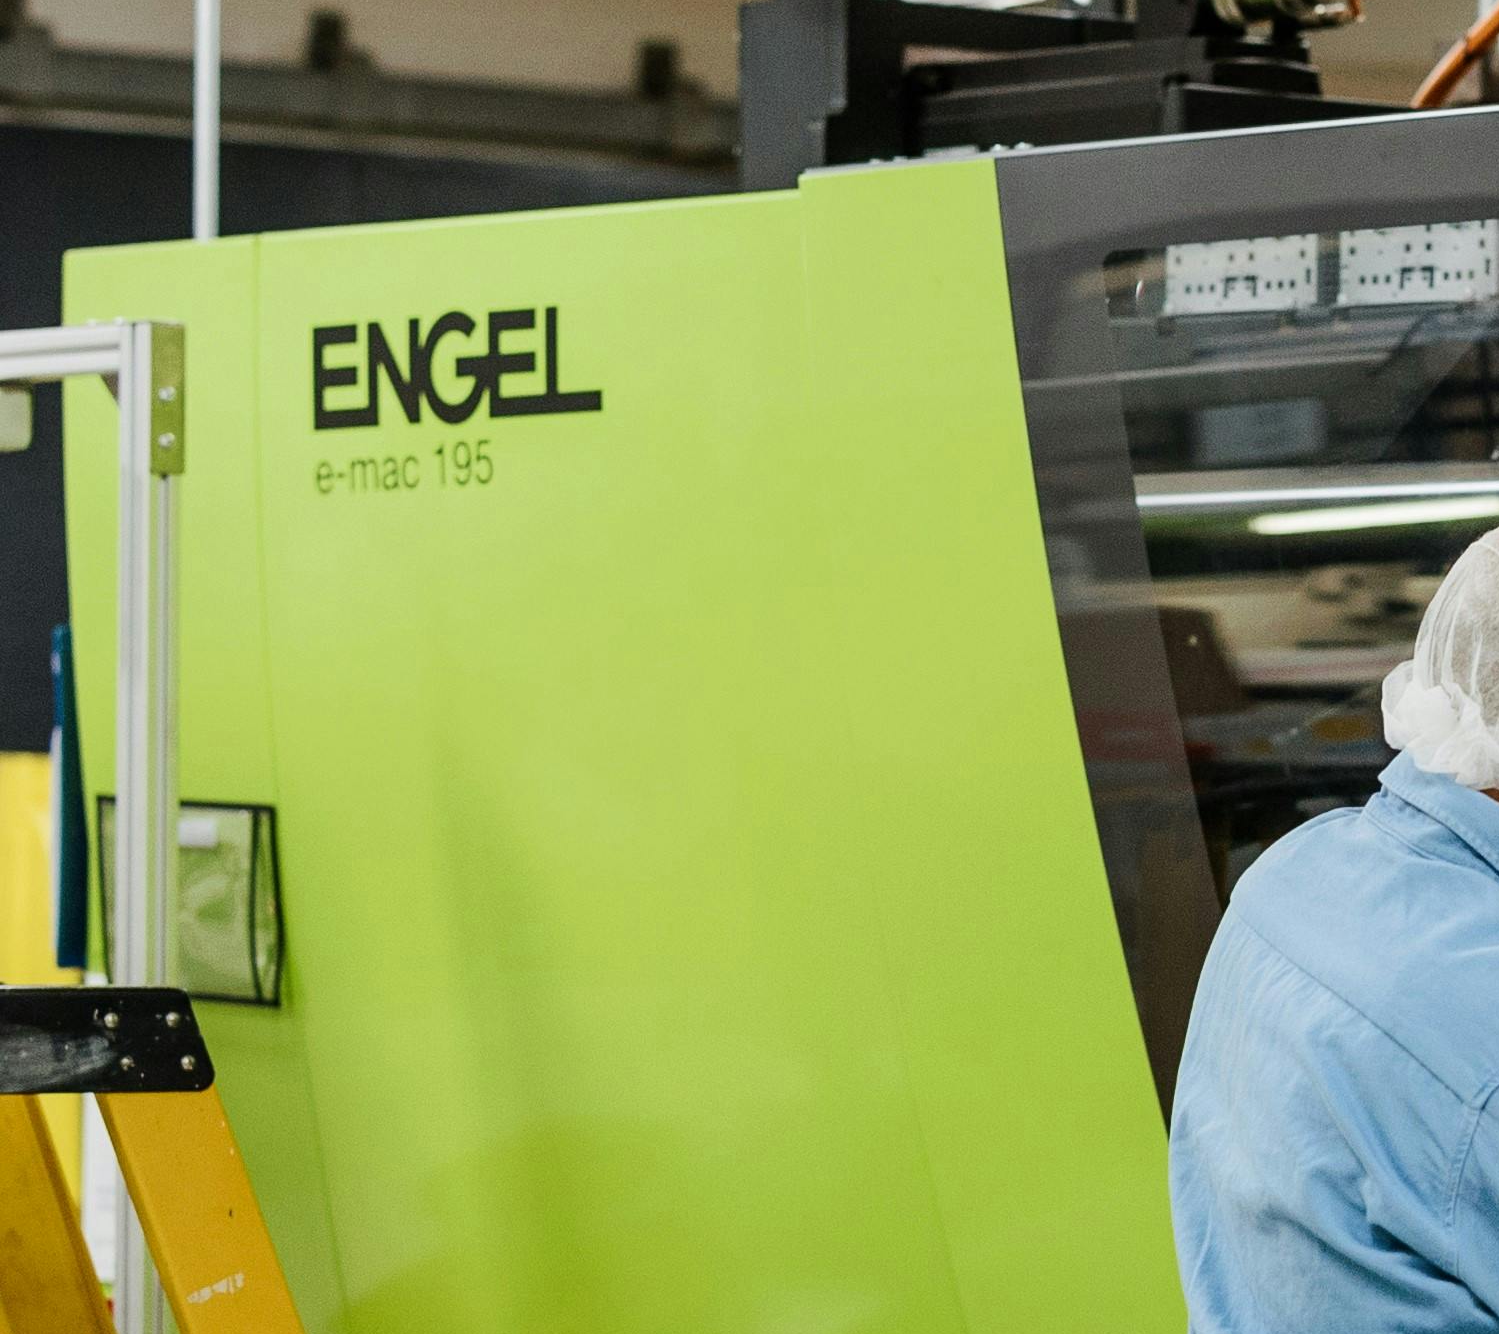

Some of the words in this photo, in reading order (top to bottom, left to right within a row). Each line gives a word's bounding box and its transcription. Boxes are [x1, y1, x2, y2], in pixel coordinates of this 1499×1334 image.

[313, 305, 602, 431] ENGEL
[315, 450, 420, 497] e-mac
[434, 439, 494, 485] 195
